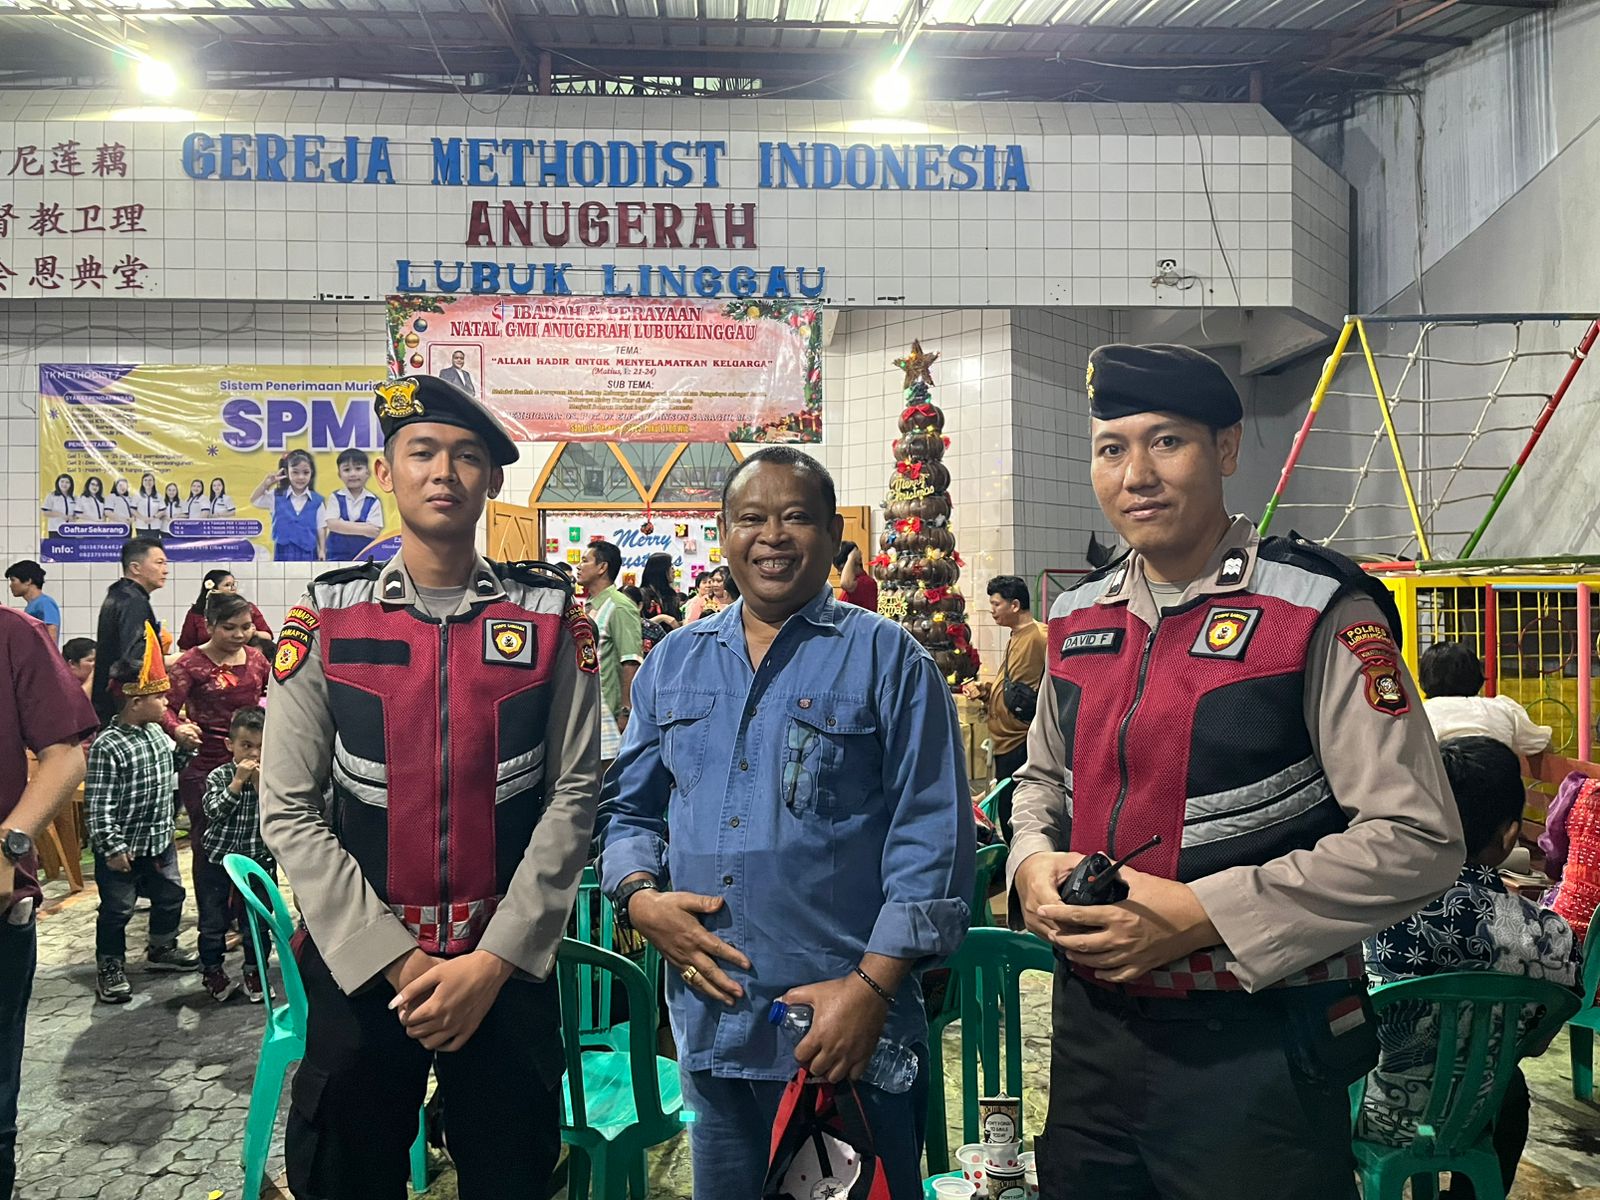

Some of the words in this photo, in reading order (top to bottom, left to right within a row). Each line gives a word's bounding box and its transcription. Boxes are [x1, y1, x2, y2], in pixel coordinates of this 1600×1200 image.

[182, 132, 396, 184] GEREJA
[431, 137, 726, 188] METHODIST
[759, 141, 1030, 191] INDONESIA
[466, 200, 757, 248] ANUGERAH
[396, 260, 573, 295] LUBUK
[601, 264, 826, 298] LINGGAU
[512, 304, 583, 320] IBADAH
[588, 306, 601, 321] &
[606, 306, 703, 322] PERAYAAN
[450, 321, 500, 337] NATAL
[505, 321, 539, 338] GMI
[542, 322, 630, 339] ANUGERAH
[634, 324, 757, 341] LUBUKLINGGAU
[616, 346, 642, 355] TEMA:
[536, 358, 570, 366] HADIR
[575, 358, 610, 366] UNTUK
[616, 359, 708, 368] MENYELAMATKAN
[219, 380, 263, 391] Sistem
[266, 380, 342, 391] Penerimaan
[607, 380, 626, 389] SUB
[628, 380, 655, 390] TEMA:
[88, 526, 124, 534] Sekarang
[612, 529, 672, 550] Merry
[51, 545, 74, 554] Info:
[1346, 625, 1387, 639] POLRES
[1064, 634, 1097, 649] DAVID
[1100, 633, 1109, 645] F
